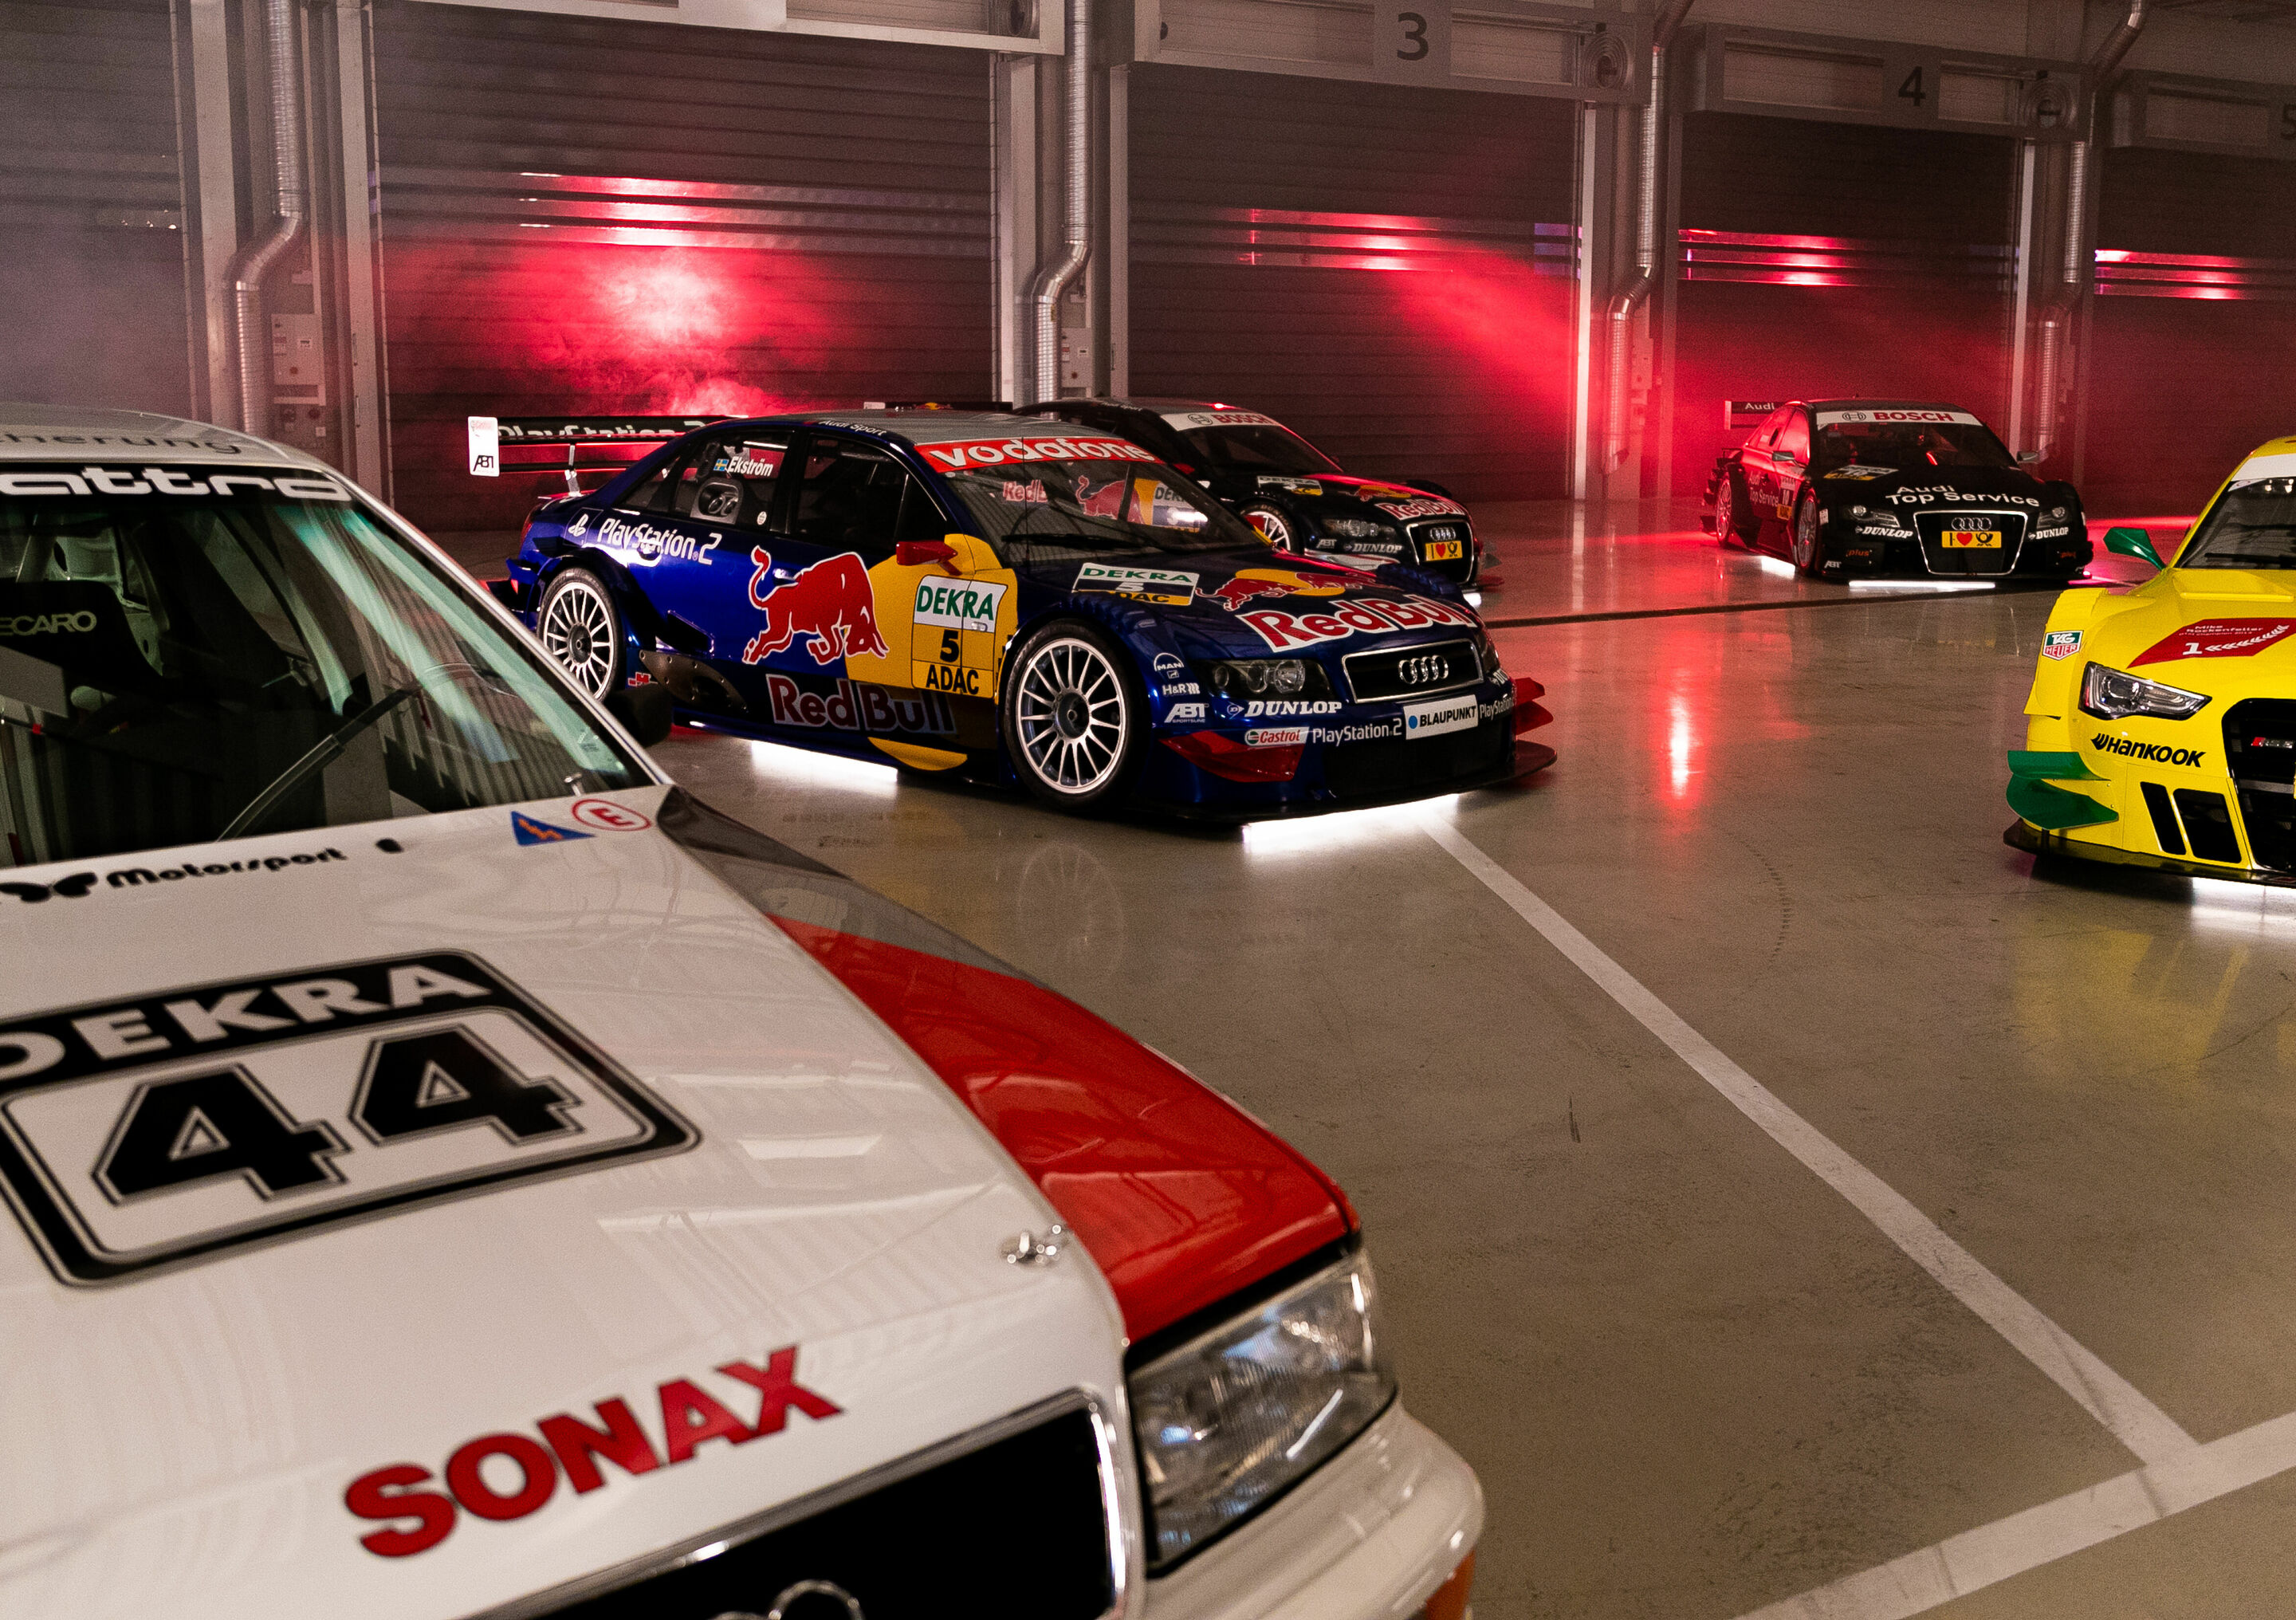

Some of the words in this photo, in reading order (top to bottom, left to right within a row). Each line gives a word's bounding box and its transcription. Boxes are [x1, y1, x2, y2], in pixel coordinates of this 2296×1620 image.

[1397, 12, 1429, 61] 3
[1898, 66, 1926, 107] 4
[1213, 414, 1273, 424] BOSCH
[1873, 411, 1954, 422] BOSCH
[819, 419, 847, 428] Audi
[851, 423, 887, 437] Sport
[0, 433, 242, 454] herung
[929, 438, 1156, 467] vodafone
[473, 455, 494, 472] ABT
[729, 456, 774, 477] Ekström
[1896, 485, 1956, 494] Audi
[1885, 492, 1935, 505] Top
[1943, 492, 2040, 508] Service
[1862, 526, 1913, 539] DUNLOP
[2036, 527, 2069, 540] DUNLOP
[1316, 539, 1337, 549] ABT
[1353, 543, 1403, 554] DUNLOP
[1083, 568, 1193, 583] DEKRA
[1116, 582, 1145, 592] 5
[917, 584, 994, 621] DEKRA
[939, 630, 959, 663] 5
[2052, 633, 2075, 644] TAG
[2045, 643, 2078, 658] HEUER
[926, 664, 980, 695] ADAC
[1164, 703, 1206, 723] ABT
[1244, 701, 1343, 717] DUNLOP
[1419, 706, 1476, 727] BLAUPUNKT
[1260, 729, 1301, 744] Castrol
[589, 808, 635, 827] E
[106, 848, 348, 887] Motorsport
[92, 1023, 584, 1206] 44
[344, 1343, 843, 1558] SONAX
